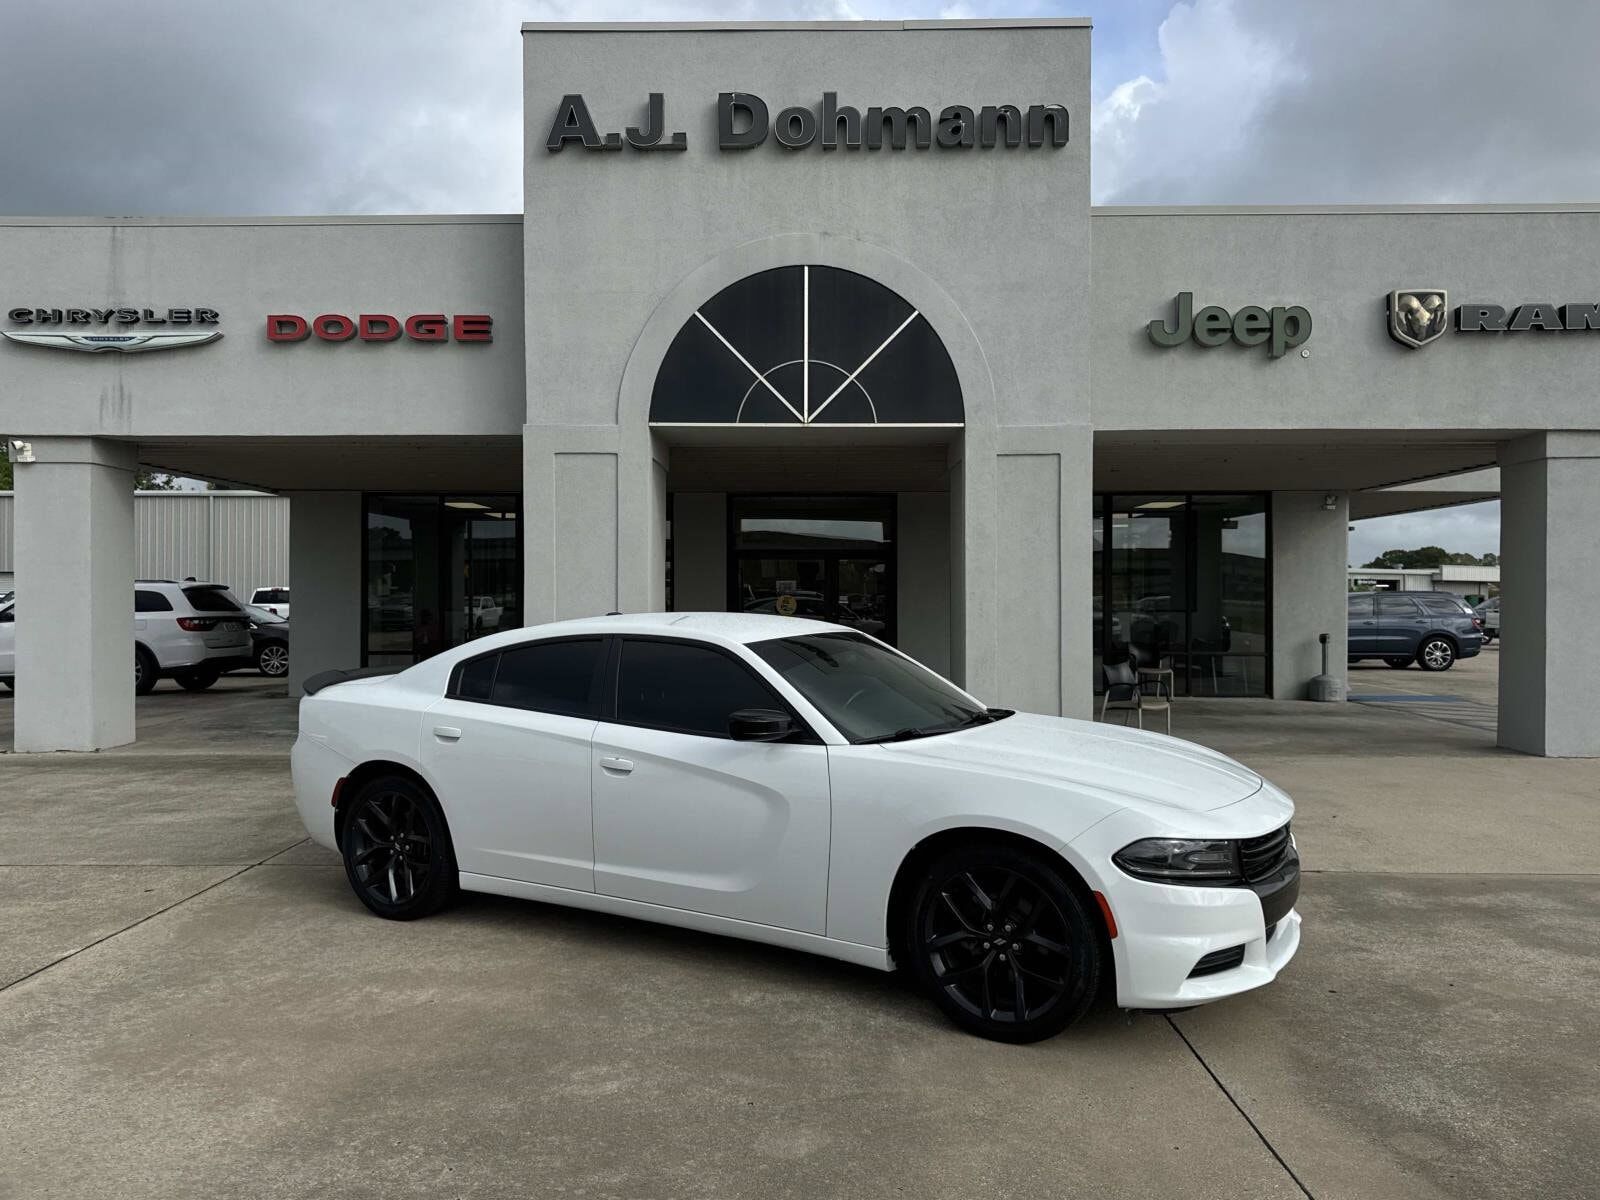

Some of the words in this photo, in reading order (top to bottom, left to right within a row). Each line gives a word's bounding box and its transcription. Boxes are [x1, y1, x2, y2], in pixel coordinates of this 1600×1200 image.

[545, 92, 688, 151] A.J.
[717, 91, 1070, 150] Dohmann
[8, 307, 220, 324] CHRYSLER
[266, 313, 494, 343] DODGE
[1149, 291, 1312, 358] Jeep
